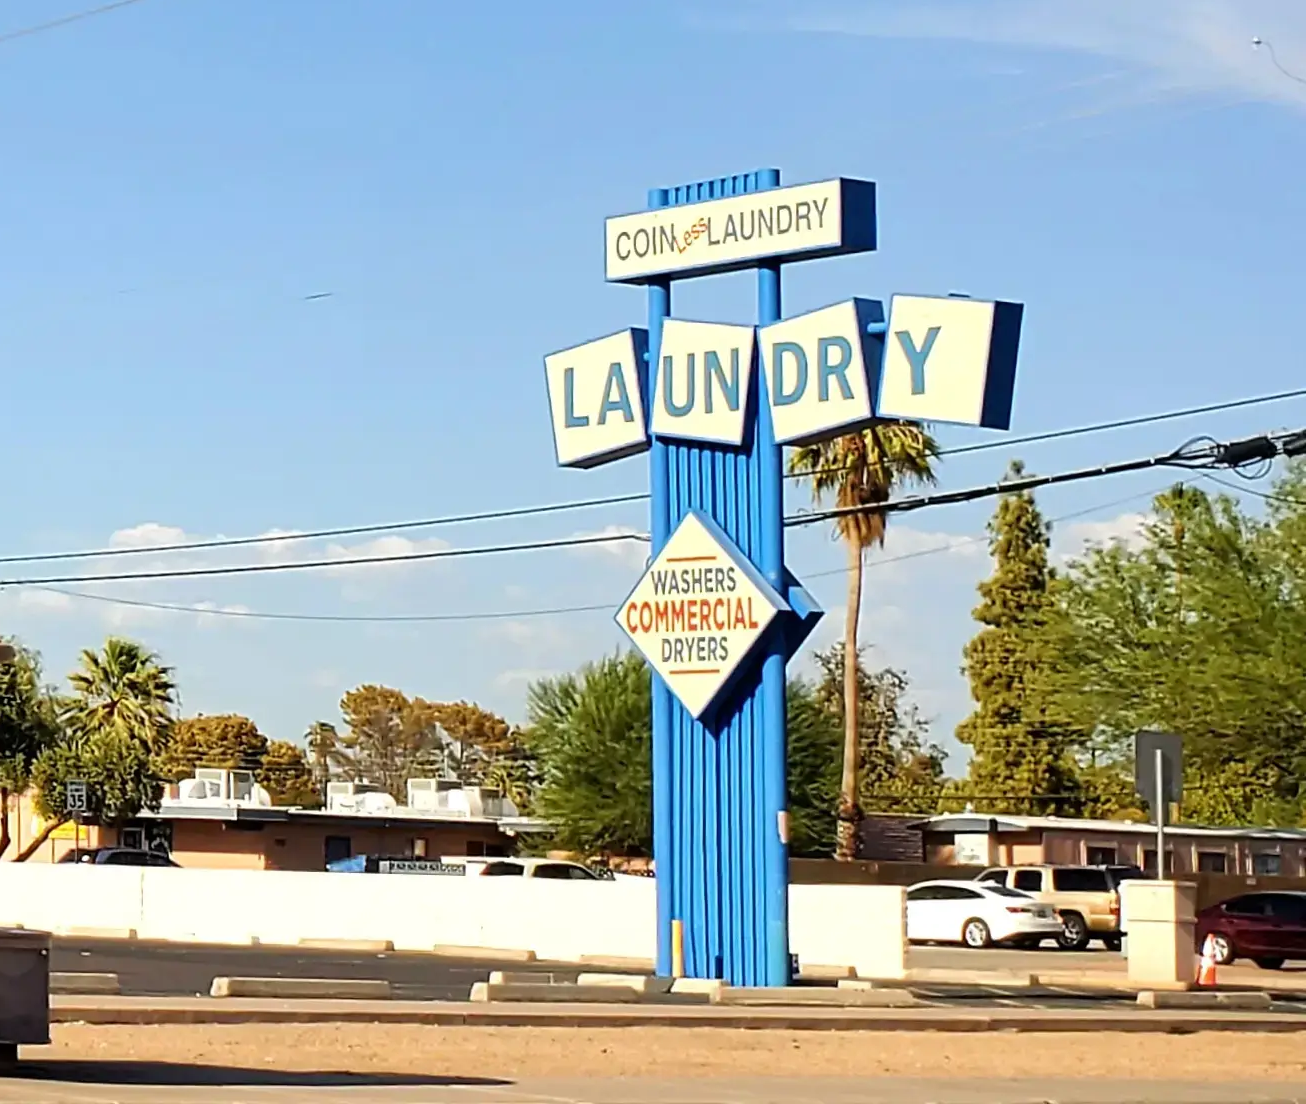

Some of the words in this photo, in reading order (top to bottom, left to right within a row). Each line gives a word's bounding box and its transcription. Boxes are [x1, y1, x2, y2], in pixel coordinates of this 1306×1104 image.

[707, 197, 829, 247] LAUNDRY
[650, 566, 737, 594] WASHERS
[626, 597, 759, 634] COMMERCIAL
[661, 636, 728, 663] DRYERS
[69, 793, 85, 809] 35
